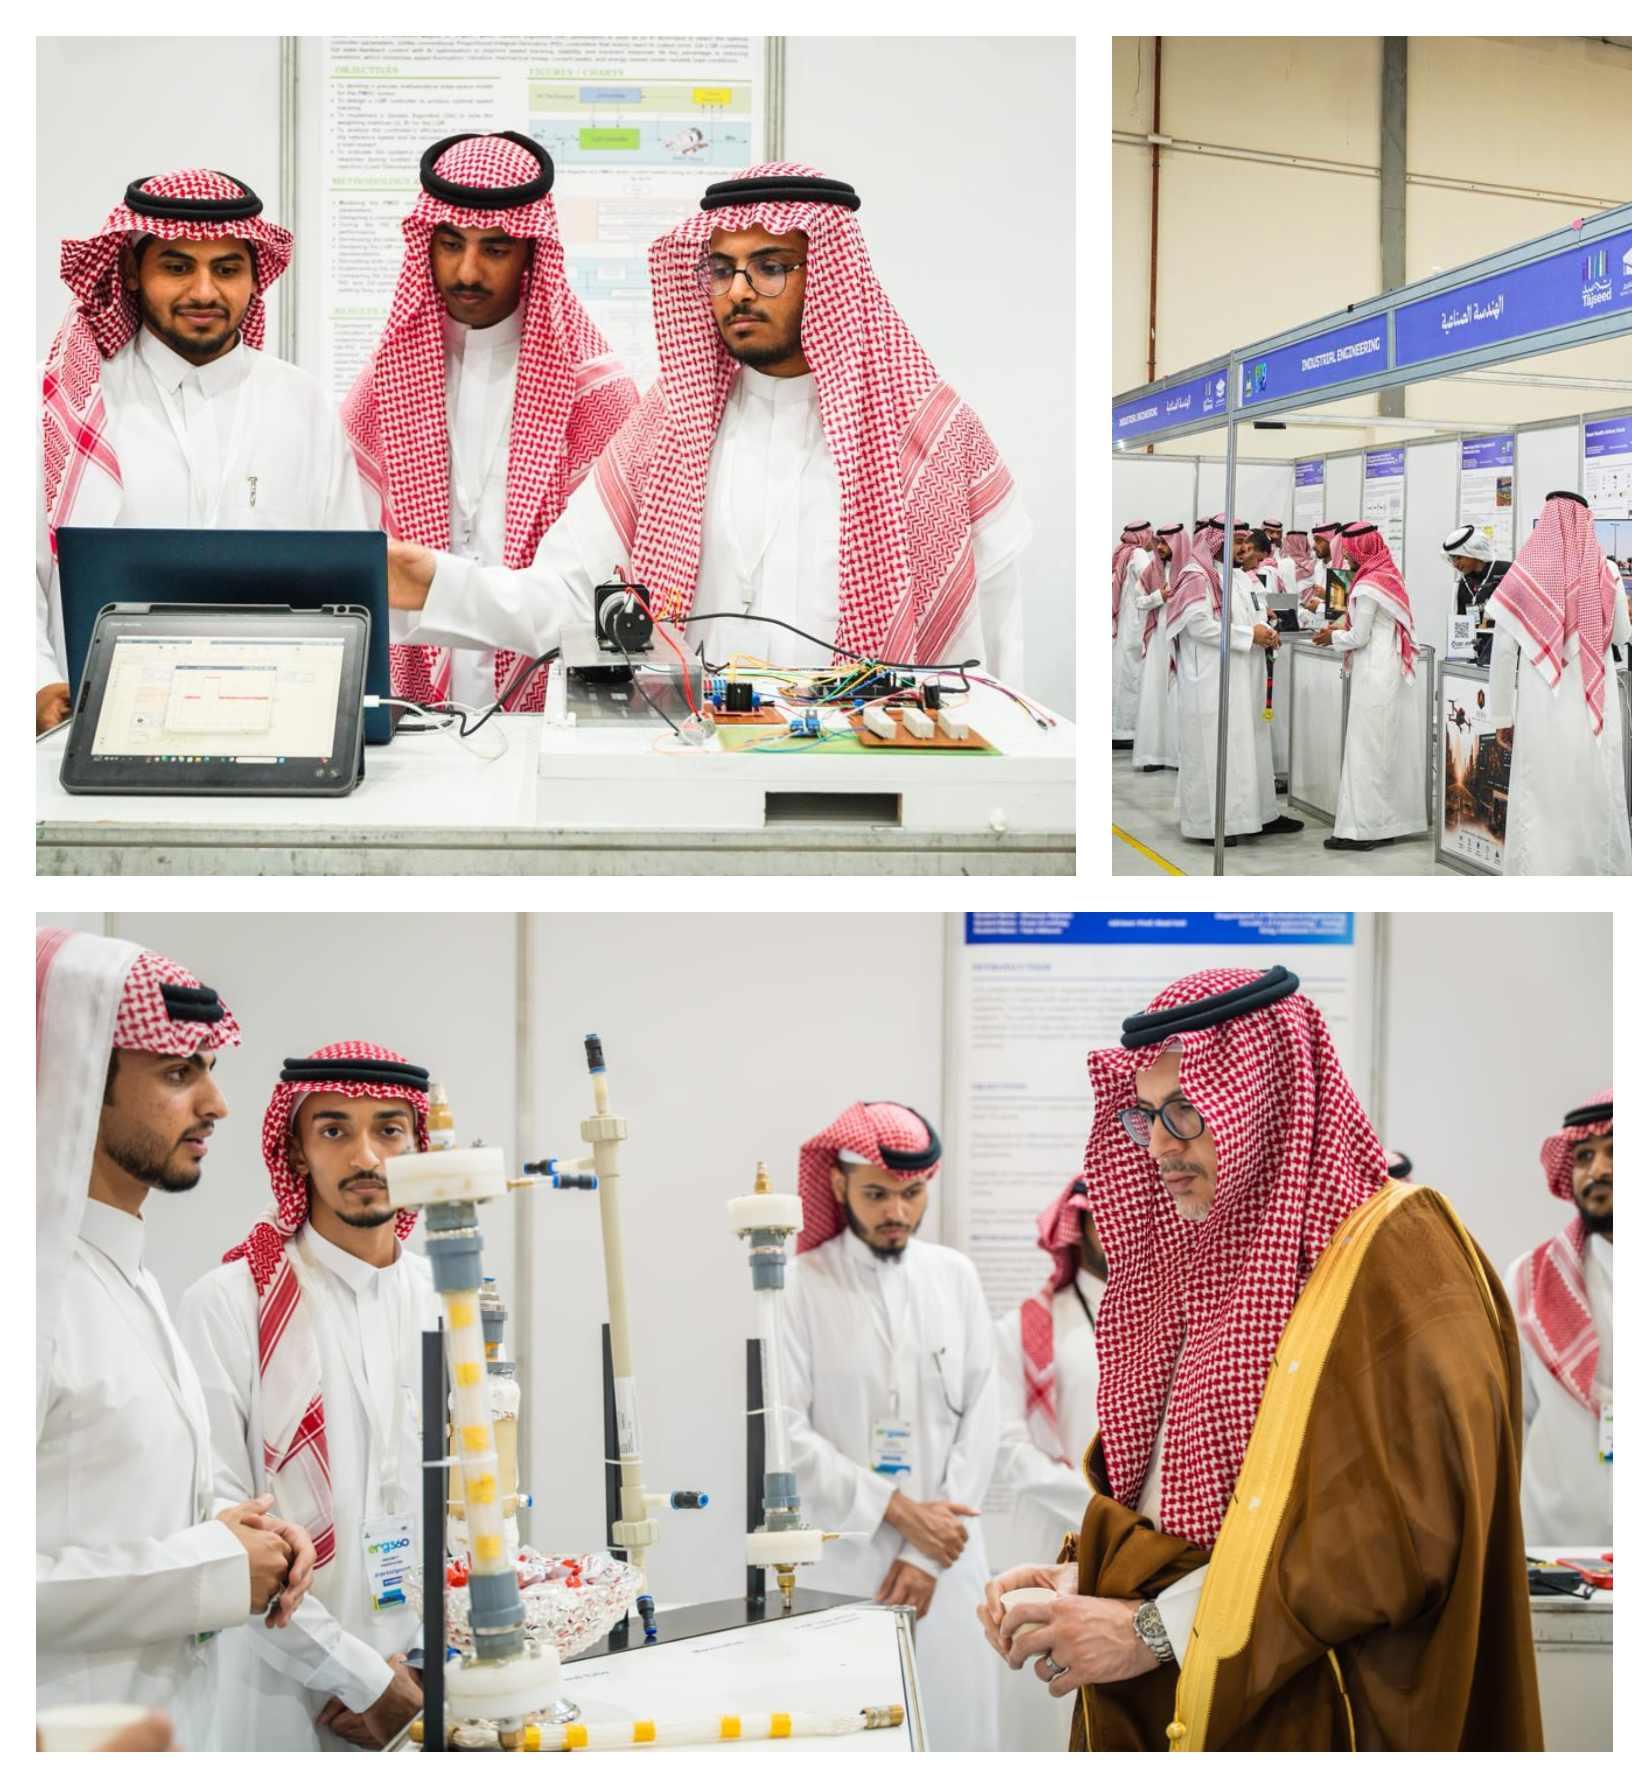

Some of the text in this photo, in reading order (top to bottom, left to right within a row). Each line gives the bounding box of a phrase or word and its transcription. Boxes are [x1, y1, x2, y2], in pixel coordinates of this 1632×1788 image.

[1441, 294, 1504, 335] الهندسة الصناعية
[1301, 336, 1380, 372] INDUSTRIAL ENGINEERING
